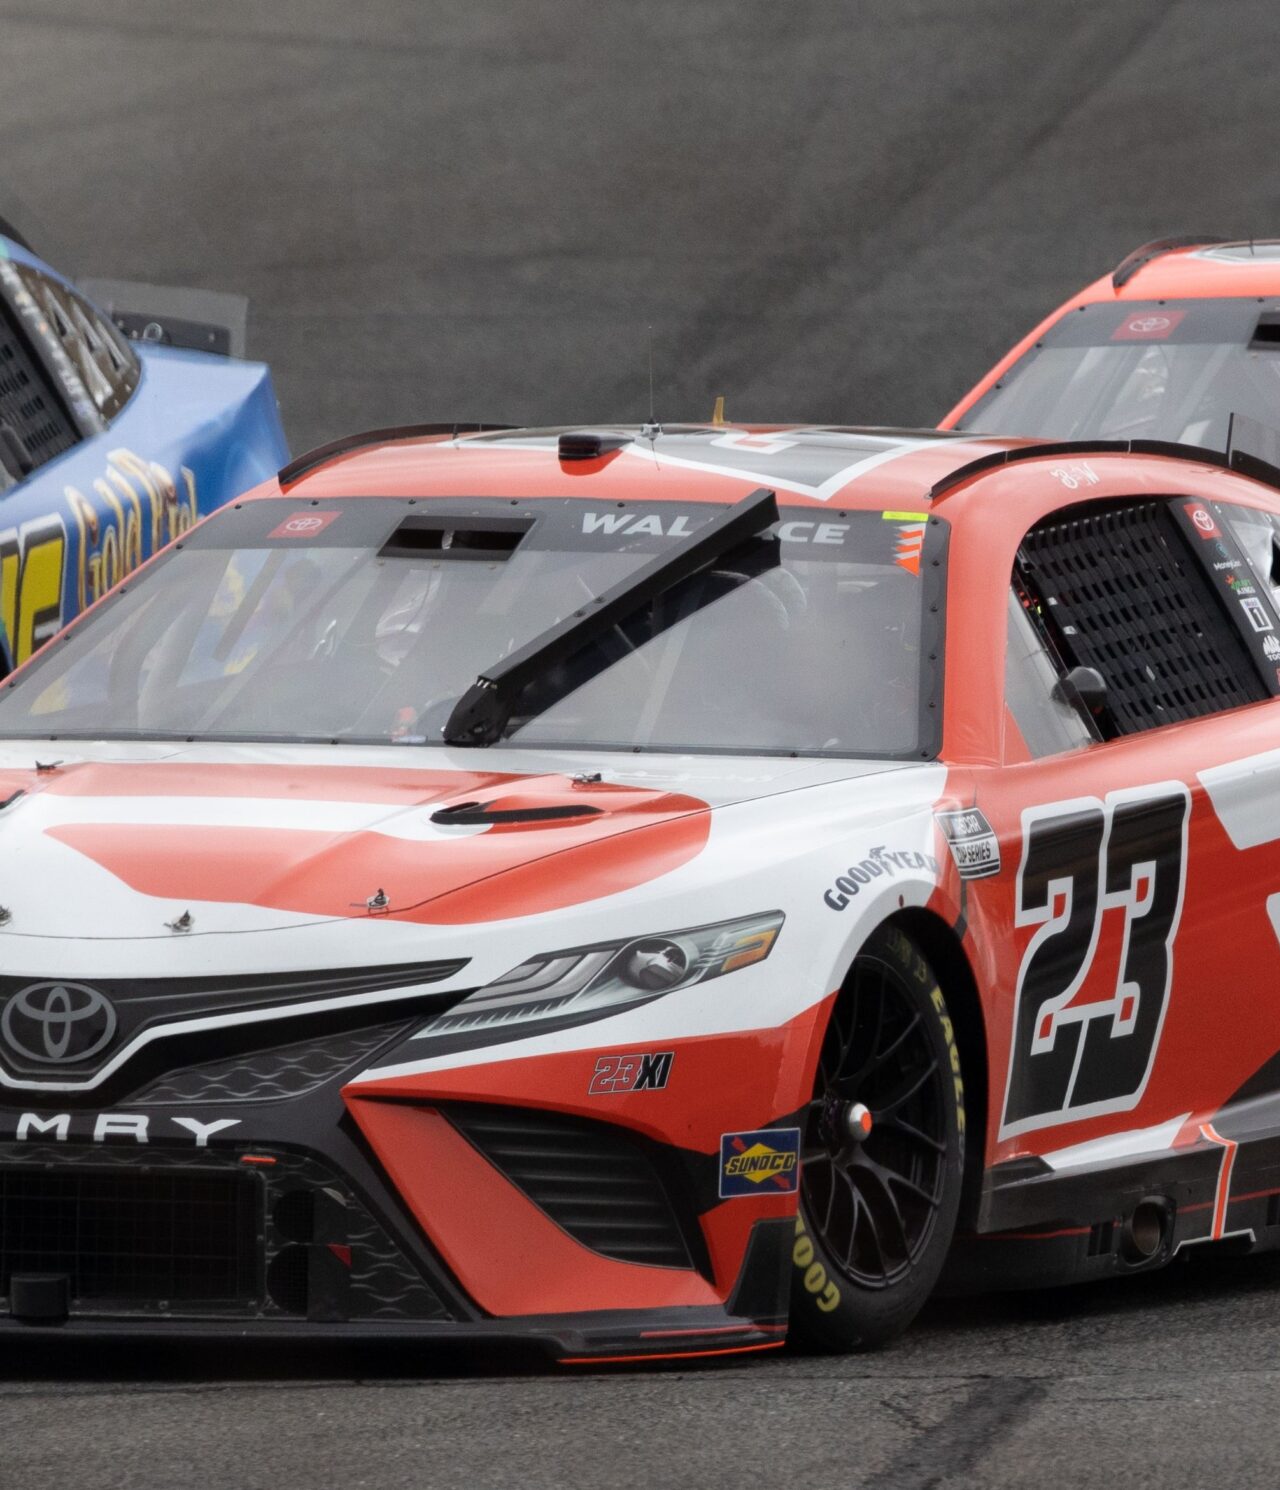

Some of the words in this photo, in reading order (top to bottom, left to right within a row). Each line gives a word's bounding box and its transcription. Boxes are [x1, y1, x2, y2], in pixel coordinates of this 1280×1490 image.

[582, 513, 850, 545] WALCE
[823, 845, 941, 912] GOODYEAR
[999, 781, 1191, 1141] 23
[588, 1052, 674, 1095] 23XI
[726, 1153, 796, 1175] SUNOCO
